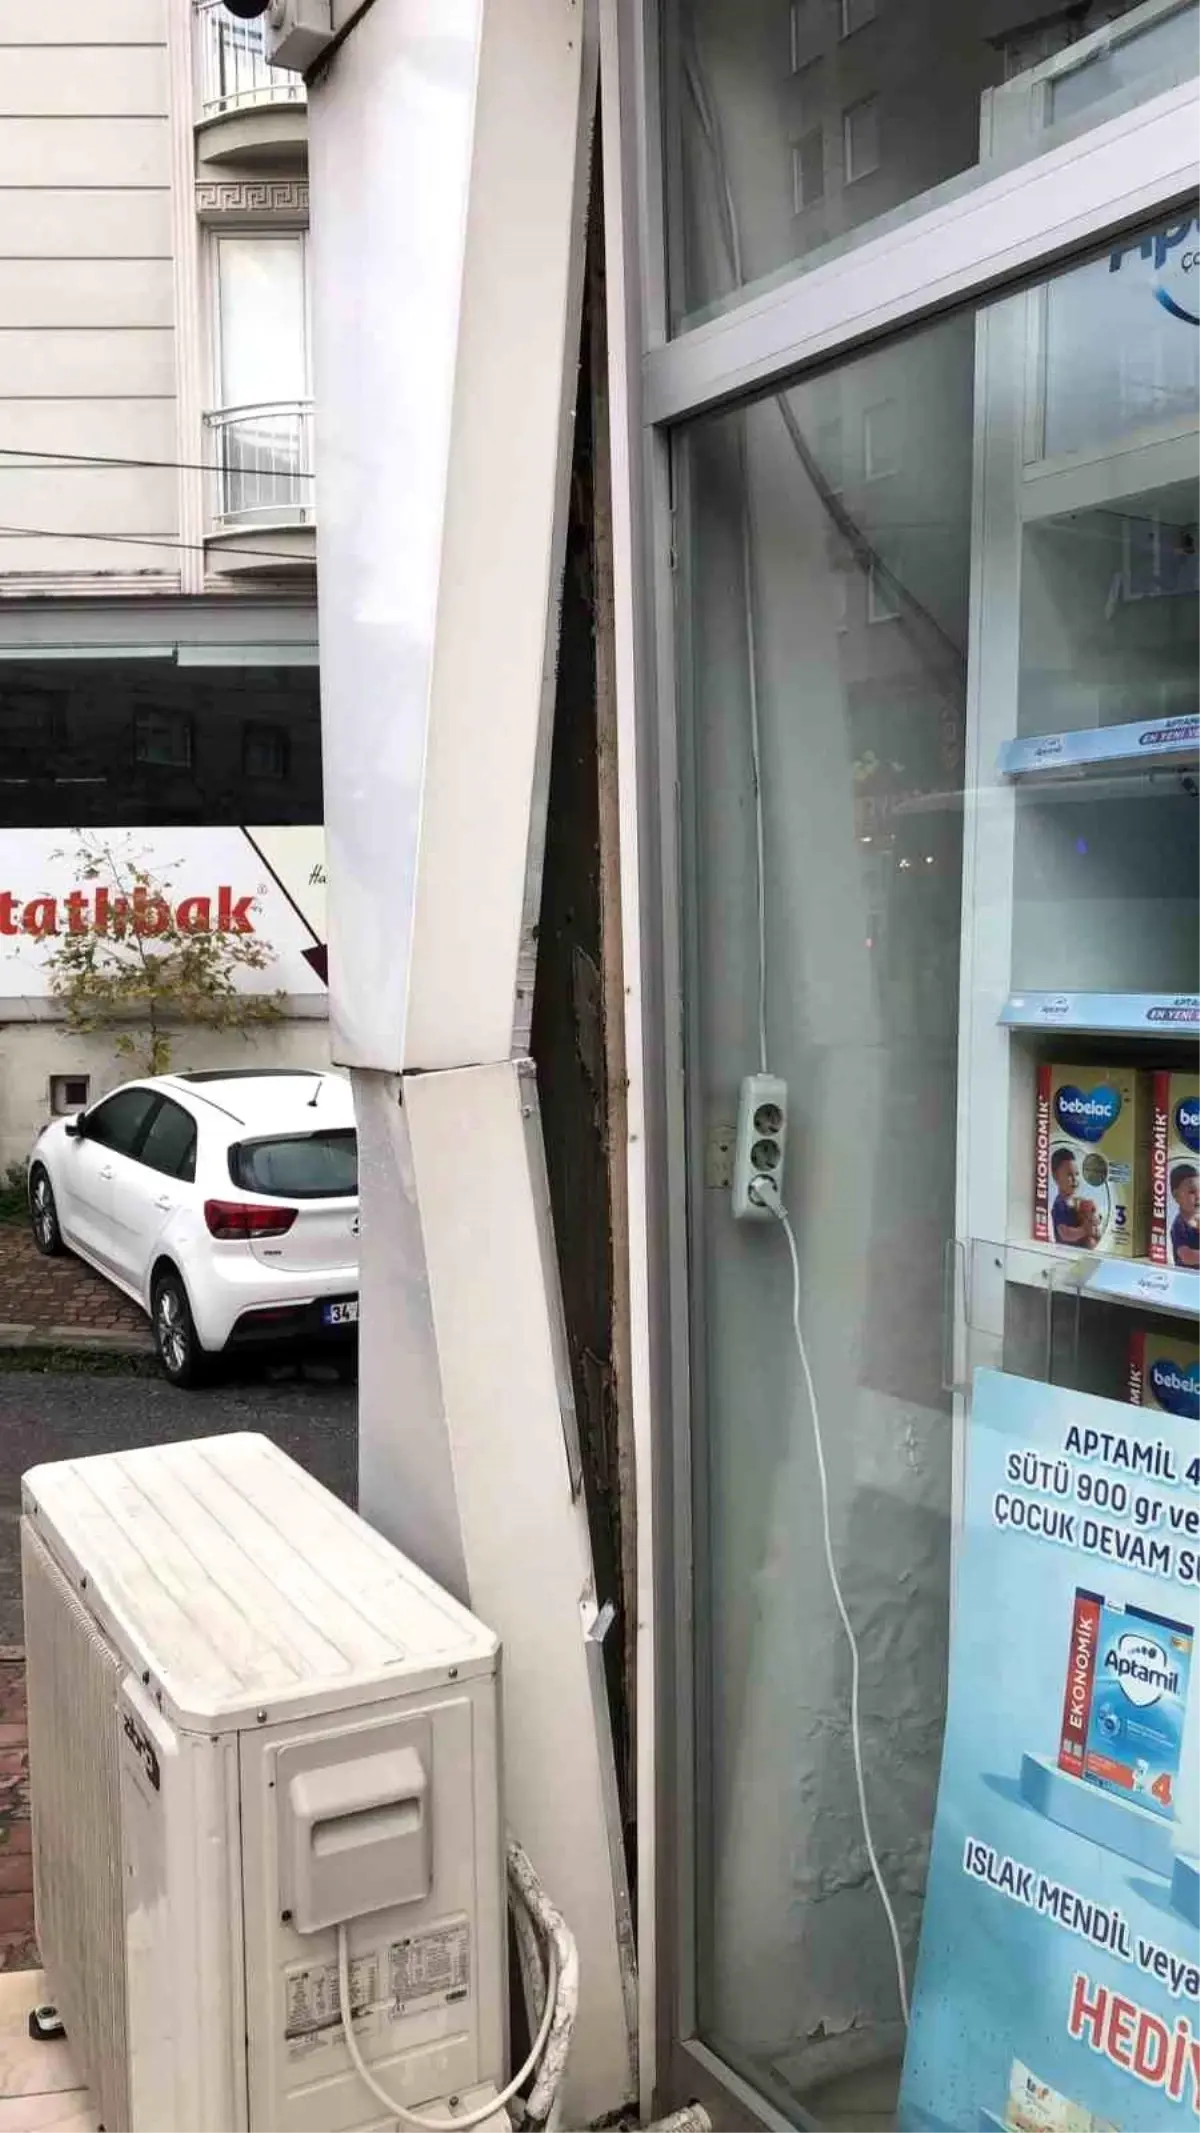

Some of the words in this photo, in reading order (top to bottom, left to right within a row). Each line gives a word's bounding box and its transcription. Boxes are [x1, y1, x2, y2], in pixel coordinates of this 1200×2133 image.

[1059, 1096, 1113, 1117] bebelac
[1180, 1108, 1200, 1126] be
[1115, 1205, 1127, 1226] 3
[1065, 1426, 1176, 1480] APTAMİL
[1008, 1452, 1070, 1494] SÜTÜ
[1077, 1474, 1127, 1511] 900
[1135, 1497, 1162, 1524] gr
[1169, 1505, 1199, 1534] ve
[994, 1493, 1074, 1543] ÇOCUK
[1083, 1521, 1170, 1573] DEVAM
[1179, 1551, 1200, 1582] S
[1069, 1615, 1095, 1729] EKONOMİK
[1104, 1649, 1179, 1694] Aptamil
[1151, 1772, 1172, 1806] 4
[966, 1841, 1031, 1902] ISLAK
[1039, 1880, 1130, 1957] MENDİL
[1139, 1940, 1200, 1993] veya
